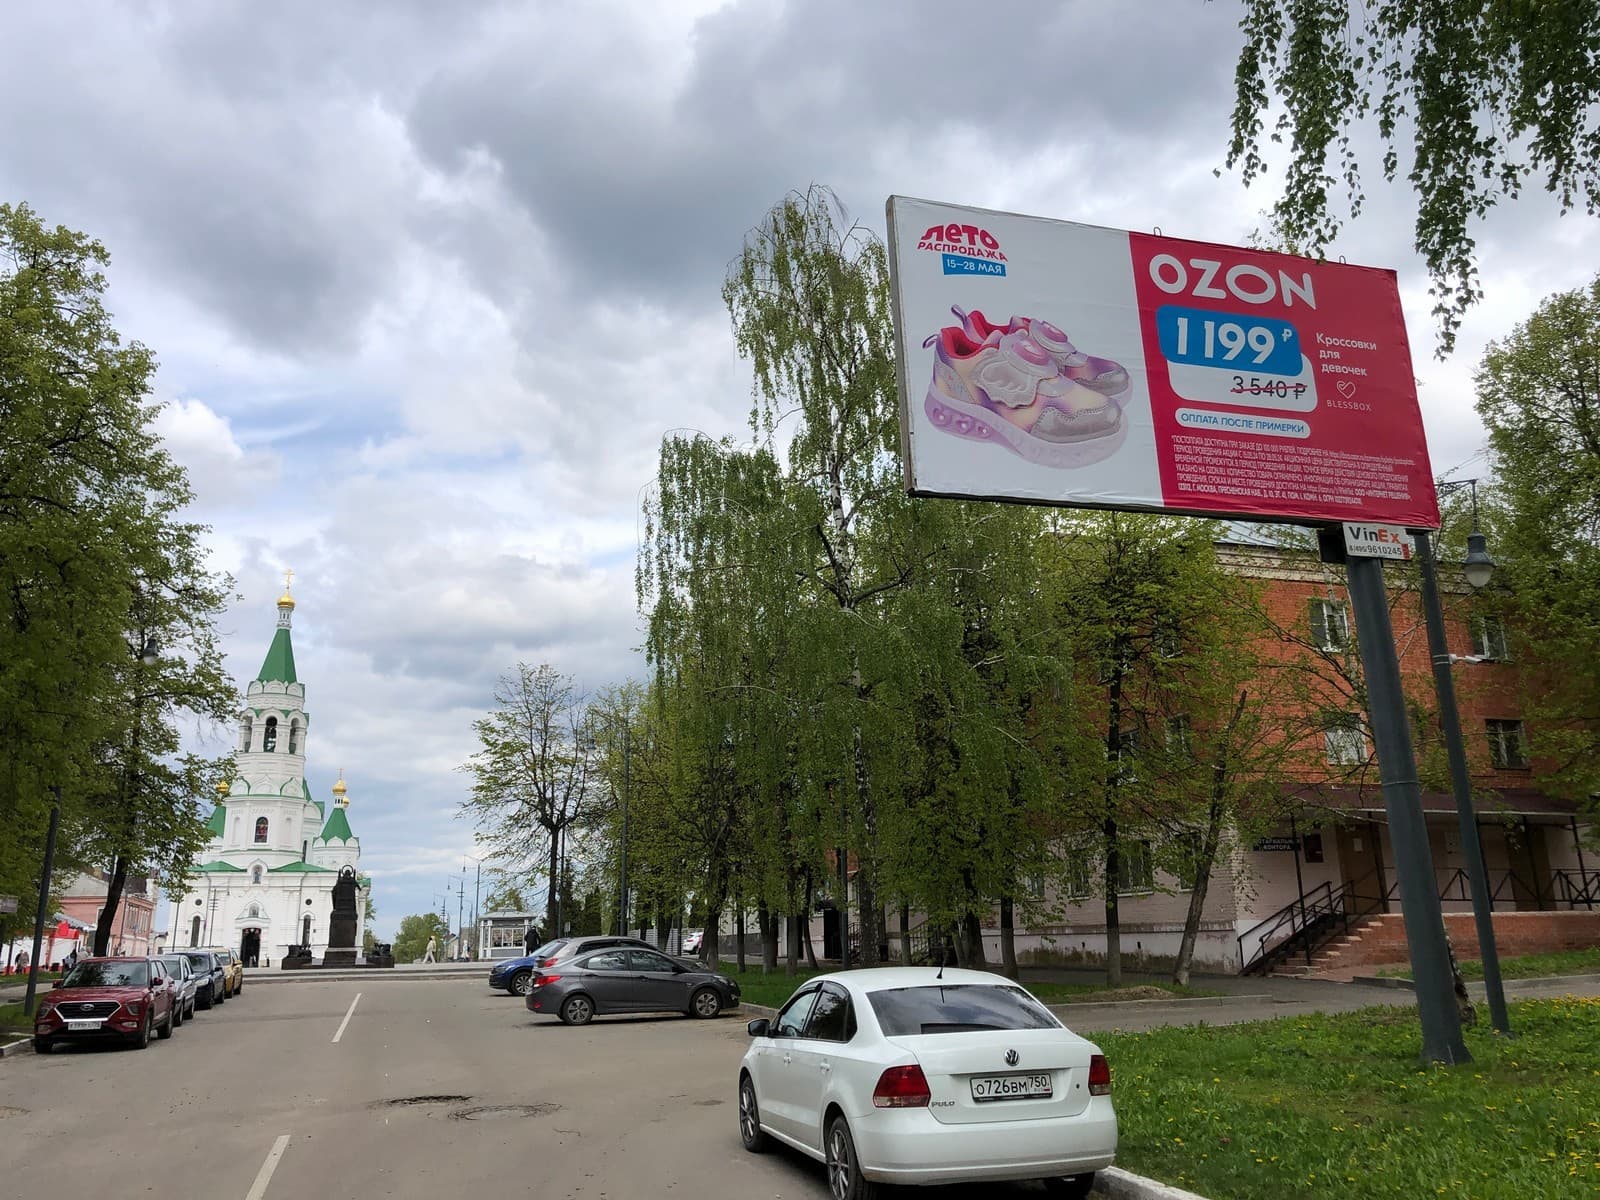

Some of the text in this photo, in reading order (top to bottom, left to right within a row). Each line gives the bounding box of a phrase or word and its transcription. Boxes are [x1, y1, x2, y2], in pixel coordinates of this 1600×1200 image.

[917, 242, 1008, 262] РАСПРОДАЖА
[978, 263, 1002, 275] МАЯ
[1149, 254, 1316, 310] OZON
[1316, 332, 1377, 350] Кроссовки
[1320, 350, 1340, 359] для
[1322, 364, 1367, 376] девочек
[1327, 400, 1371, 411] BLESSBOX
[1181, 413, 1304, 433] ОПЛАТА ПОСЛЕ ПРИМЕРКИ
[1349, 526, 1402, 543] VinEx
